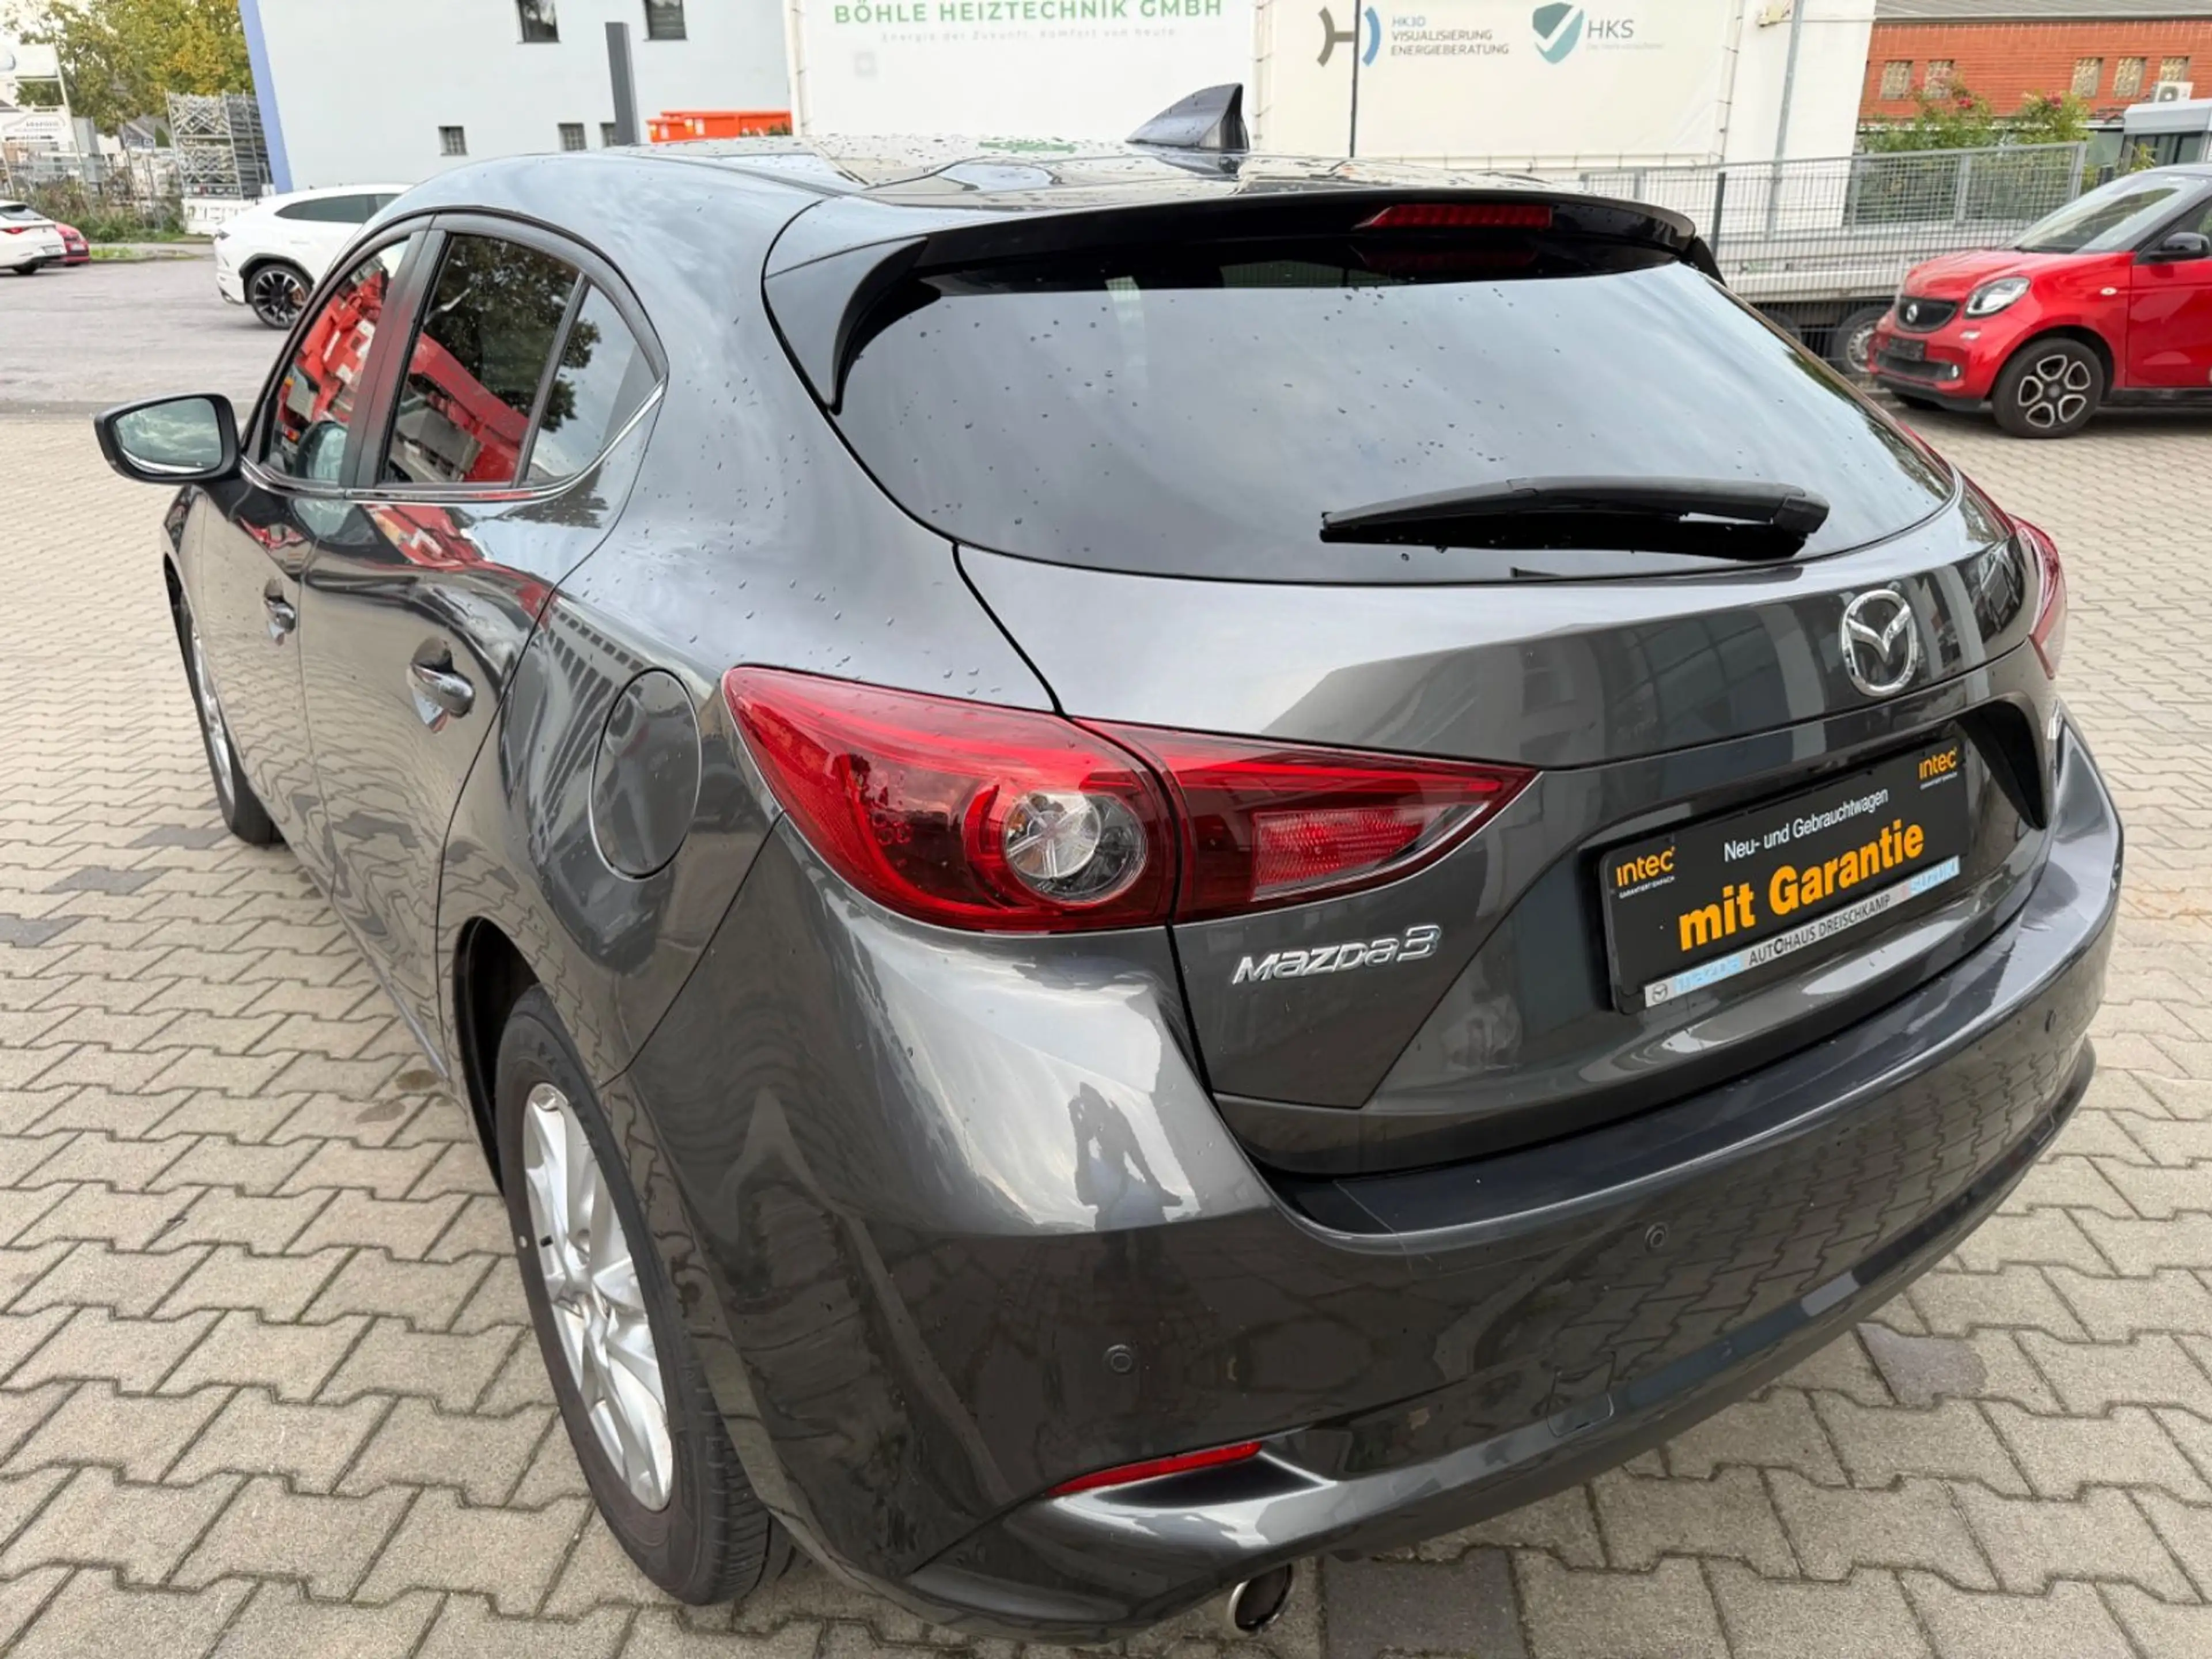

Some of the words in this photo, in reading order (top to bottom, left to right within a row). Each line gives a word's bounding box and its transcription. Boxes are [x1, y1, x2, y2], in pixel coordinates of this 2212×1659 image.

[834, 0, 927, 23] BÖHLE
[940, 1, 1127, 22] HEIZTECHNIK
[1139, 0, 1221, 17] GMBH
[1391, 29, 1493, 41] VISUALISIERUNG
[1587, 19, 1635, 39] HKS
[1391, 43, 1510, 56] ENERGIEBERATUNG
[1724, 839, 1761, 862] Neu-
[1763, 823, 1790, 850] und
[1793, 788, 1888, 839] Gebrauchtwagen
[1679, 882, 1756, 952] mit
[1769, 819, 1925, 915] Garantie
[1748, 926, 1816, 966] AUTOHAUS
[1819, 893, 1891, 937] DREISCHKAMP
